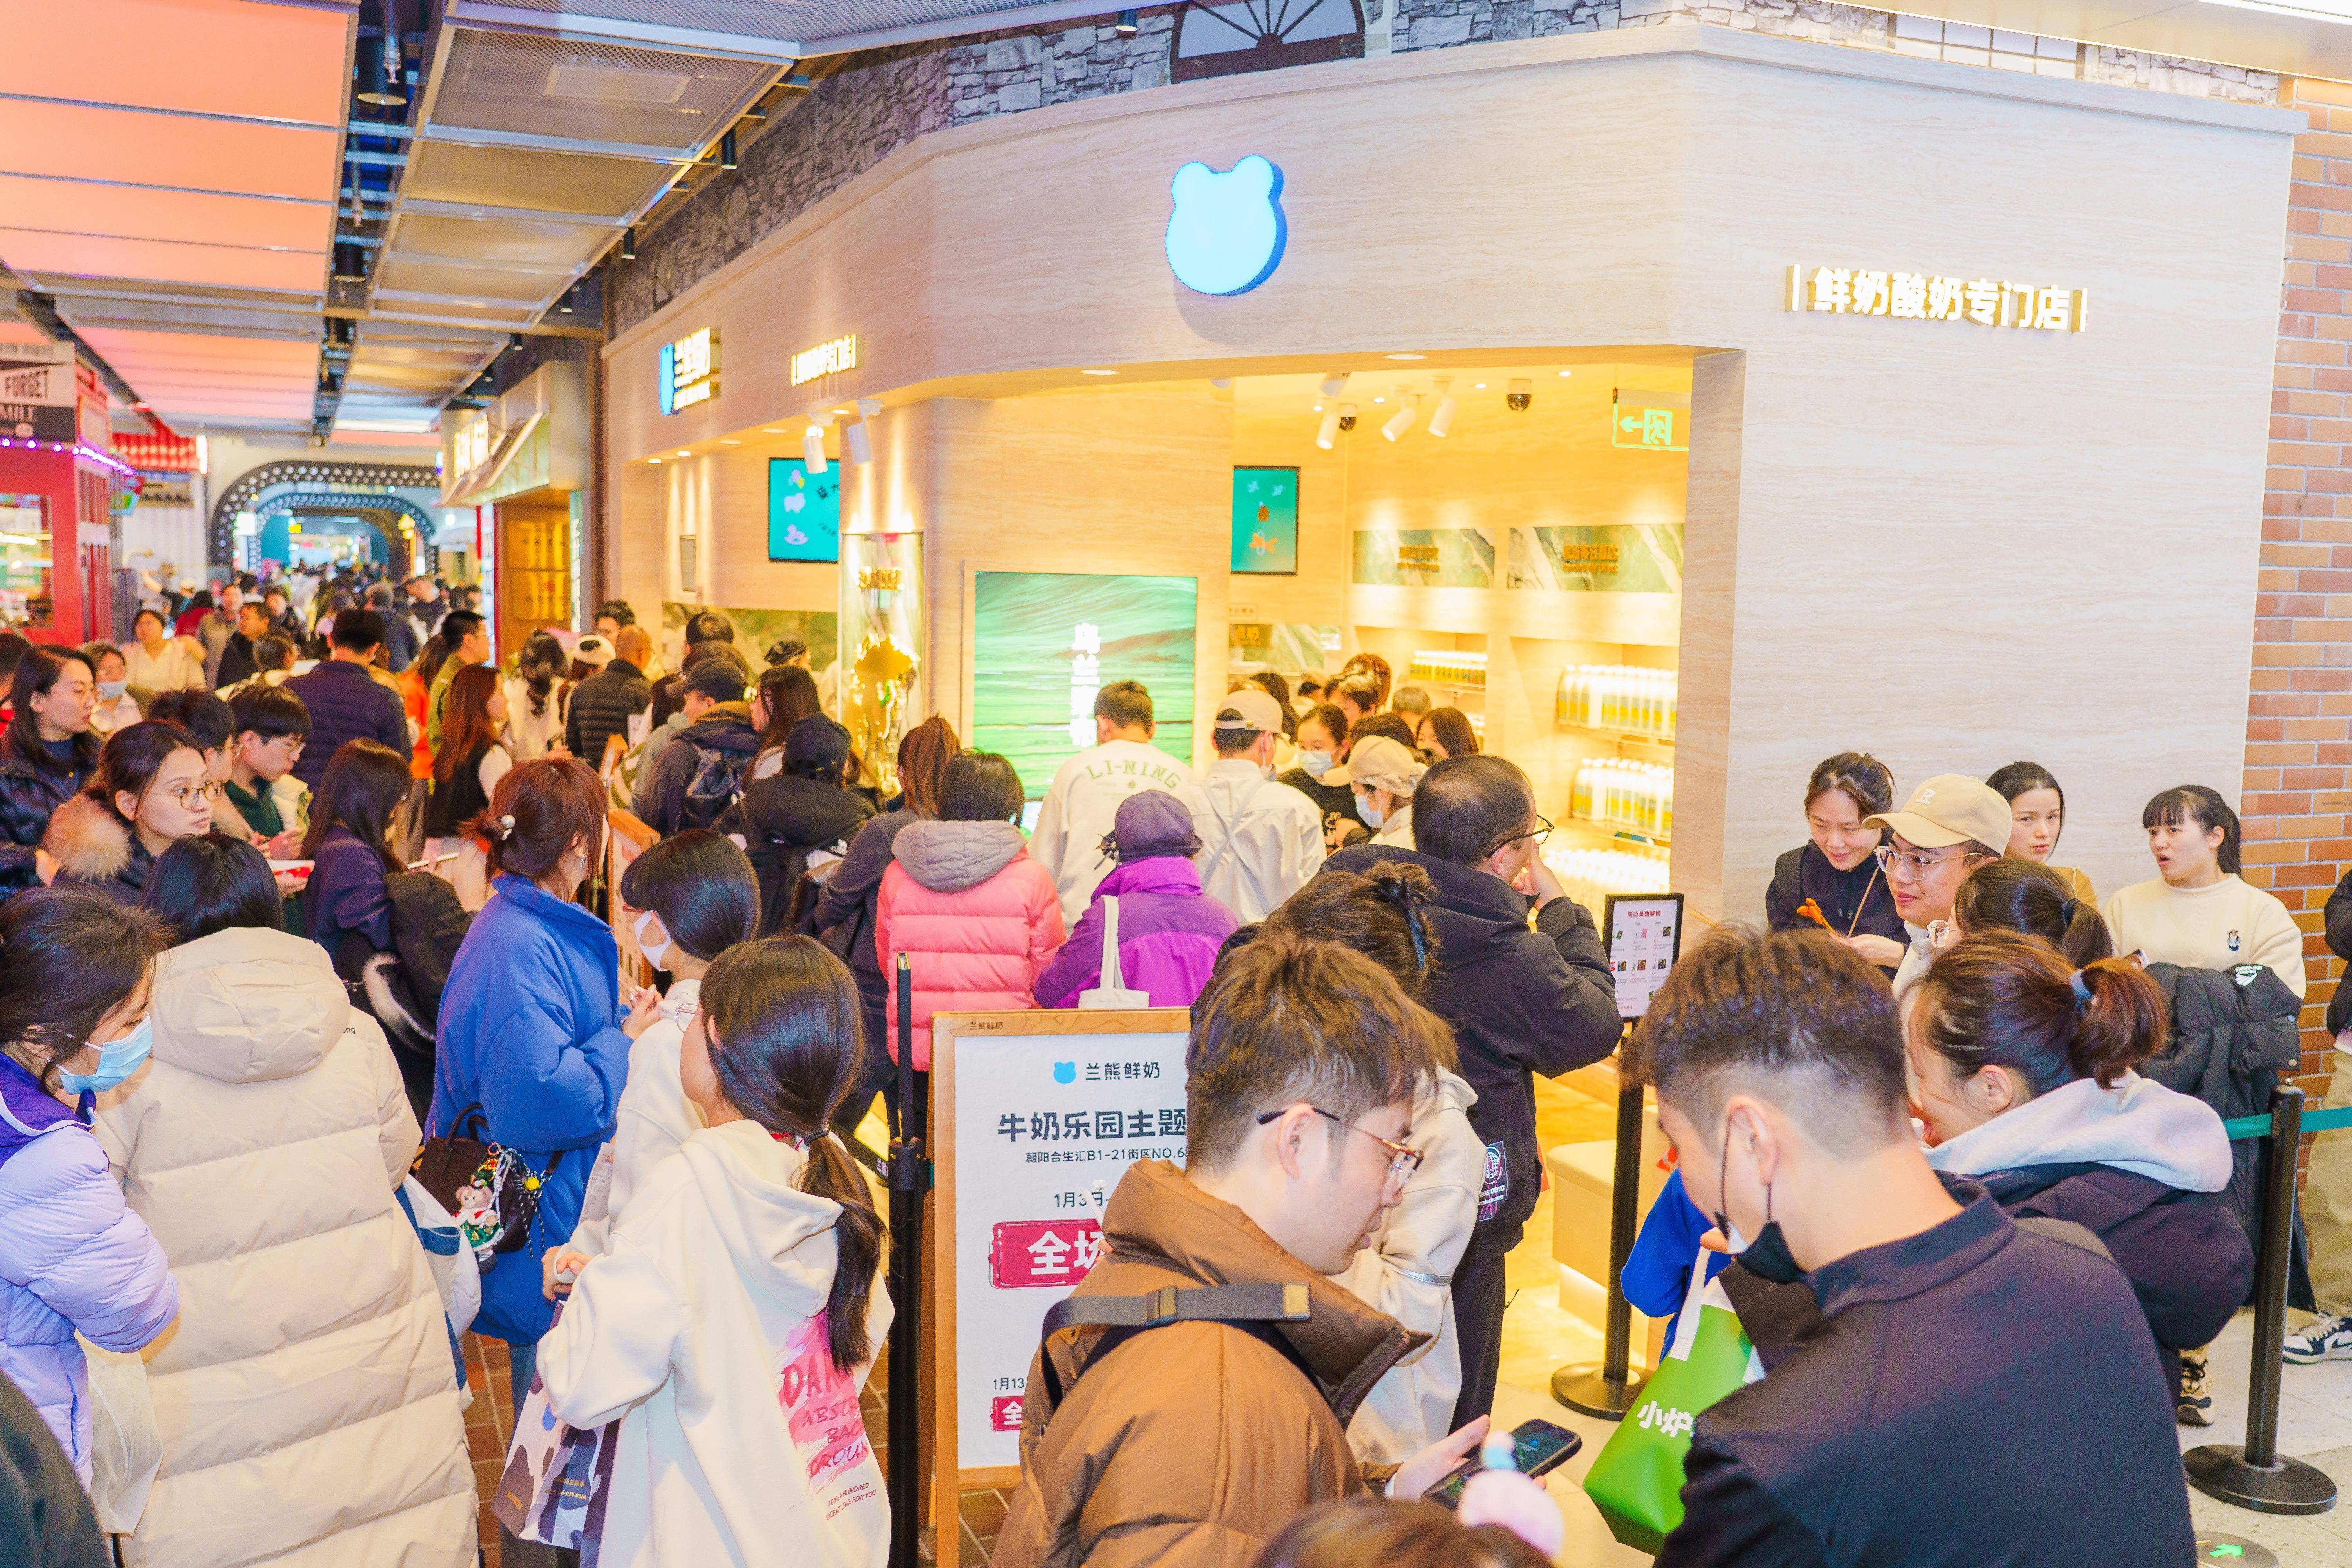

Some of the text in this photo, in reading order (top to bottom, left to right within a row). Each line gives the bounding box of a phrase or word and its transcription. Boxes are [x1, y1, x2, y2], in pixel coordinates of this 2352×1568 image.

[1810, 266, 2071, 330] 鲜奶酸奶专门店
[5, 370, 49, 399] FORGET
[1085, 759, 1181, 789] LI-NING
[1916, 788, 1935, 806] R
[969, 1021, 1004, 1030] 兰熊鲜奶
[1085, 1061, 1160, 1080] 兰熊鲜奶
[998, 1108, 1187, 1142] 牛奶乐园主题
[993, 1378, 1024, 1390] 1月13
[1002, 1401, 1023, 1425] 全
[1637, 1401, 1695, 1438] 小炉
[841, 1498, 852, 1510] LOVE
[851, 1494, 864, 1503] FOR
[865, 1489, 877, 1499] YOU
[843, 1482, 869, 1497] HUNDRED
